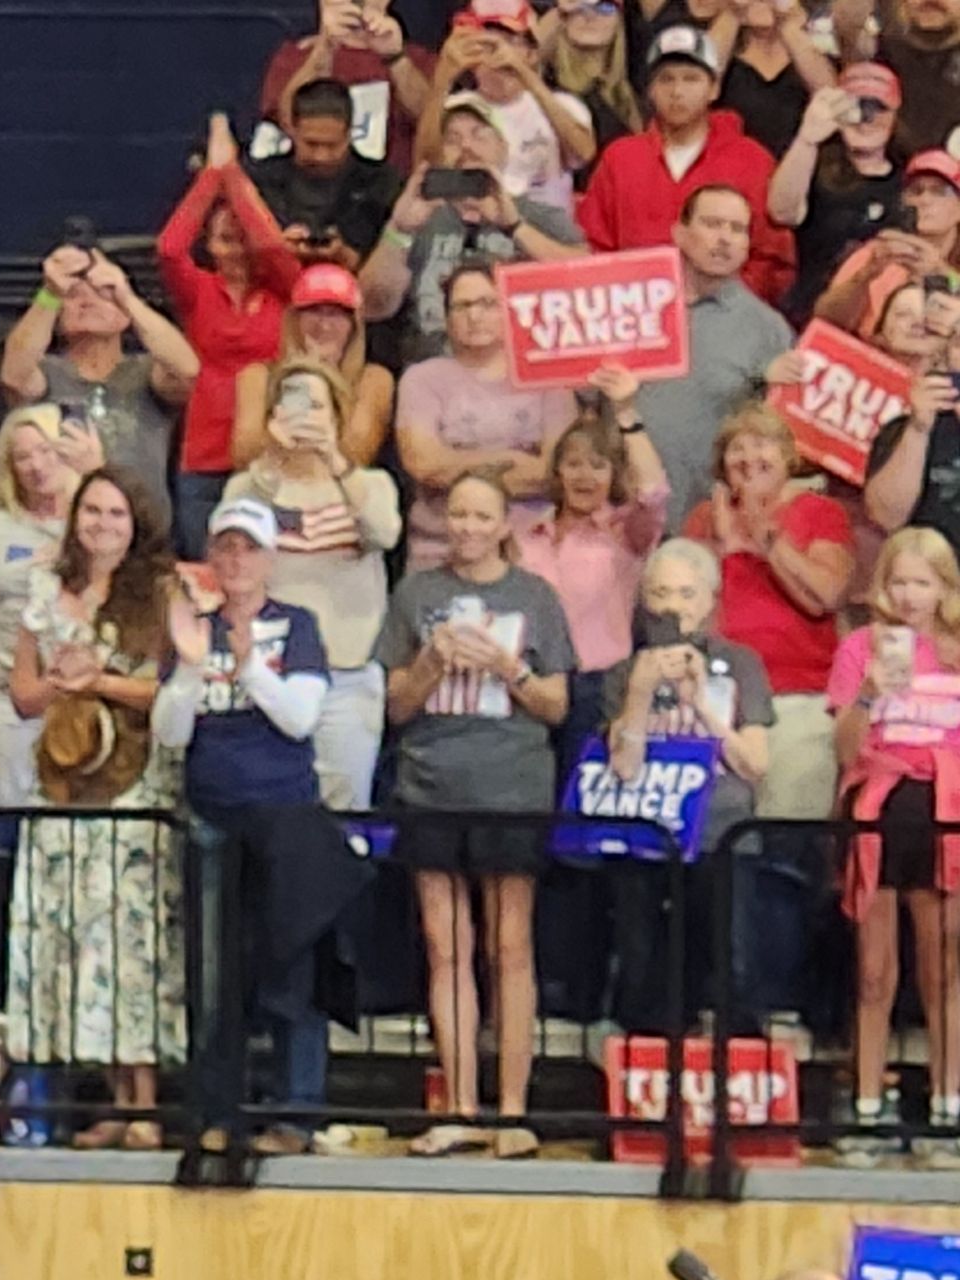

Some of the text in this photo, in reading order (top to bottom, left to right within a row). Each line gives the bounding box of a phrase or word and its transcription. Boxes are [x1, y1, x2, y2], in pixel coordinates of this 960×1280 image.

[508, 278, 677, 328] TRUMP
[531, 311, 664, 350] VANCE
[580, 791, 686, 818] VANCE
